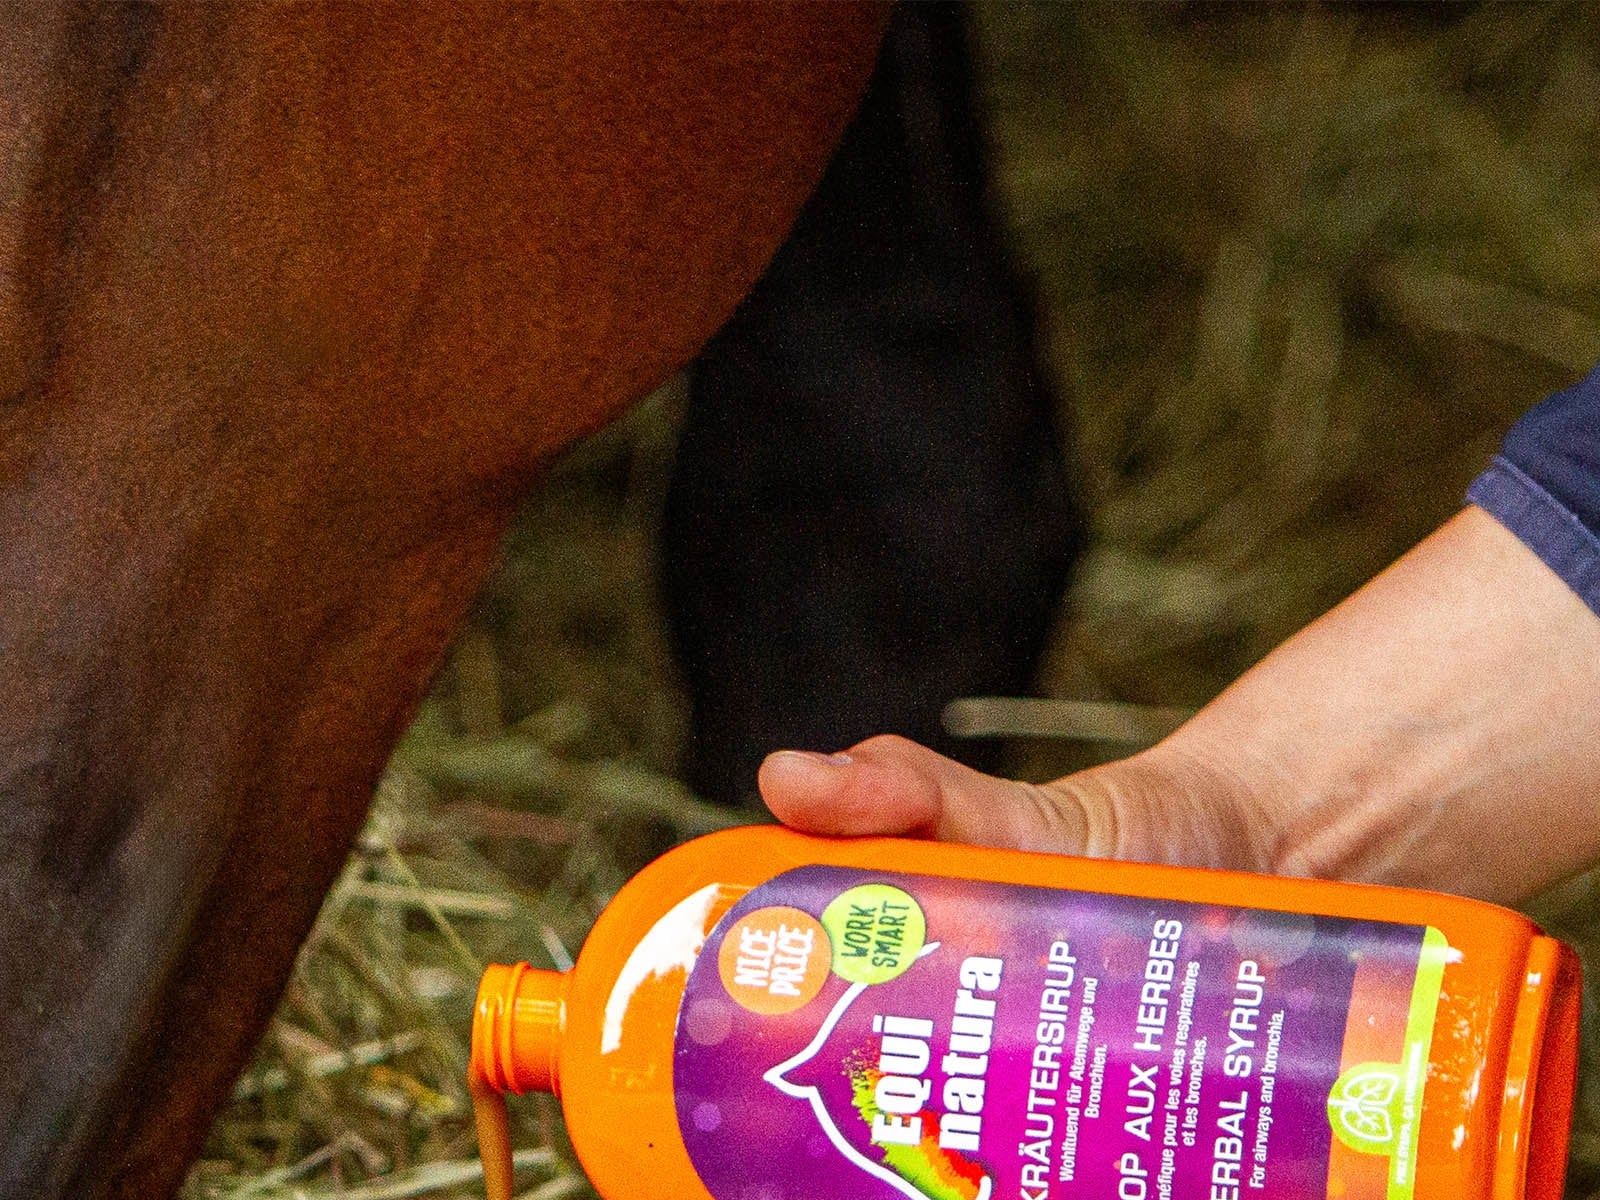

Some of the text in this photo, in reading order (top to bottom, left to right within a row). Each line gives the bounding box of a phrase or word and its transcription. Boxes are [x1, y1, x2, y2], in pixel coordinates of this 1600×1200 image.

[734, 926, 777, 986] NICE
[769, 924, 813, 996] PRICE
[841, 904, 877, 958] WORK
[872, 901, 909, 968] SMART
[1133, 919, 1183, 1051] HERBES
[1175, 961, 1200, 1046] respiratoires
[1224, 960, 1266, 1077] SYRUP
[938, 956, 1004, 1151] natura
[1059, 977, 1098, 1182] Wohltuend für Atemwege und
[1084, 1044, 1107, 1119] Bronchien.
[1169, 1048, 1185, 1084] voies
[1182, 1036, 1207, 1146] et les bronches.
[1124, 1063, 1158, 1141] AUX
[1162, 1112, 1178, 1147] pour
[1164, 1088, 1180, 1110] les
[1249, 1010, 1284, 1189] For airways and bronchia.
